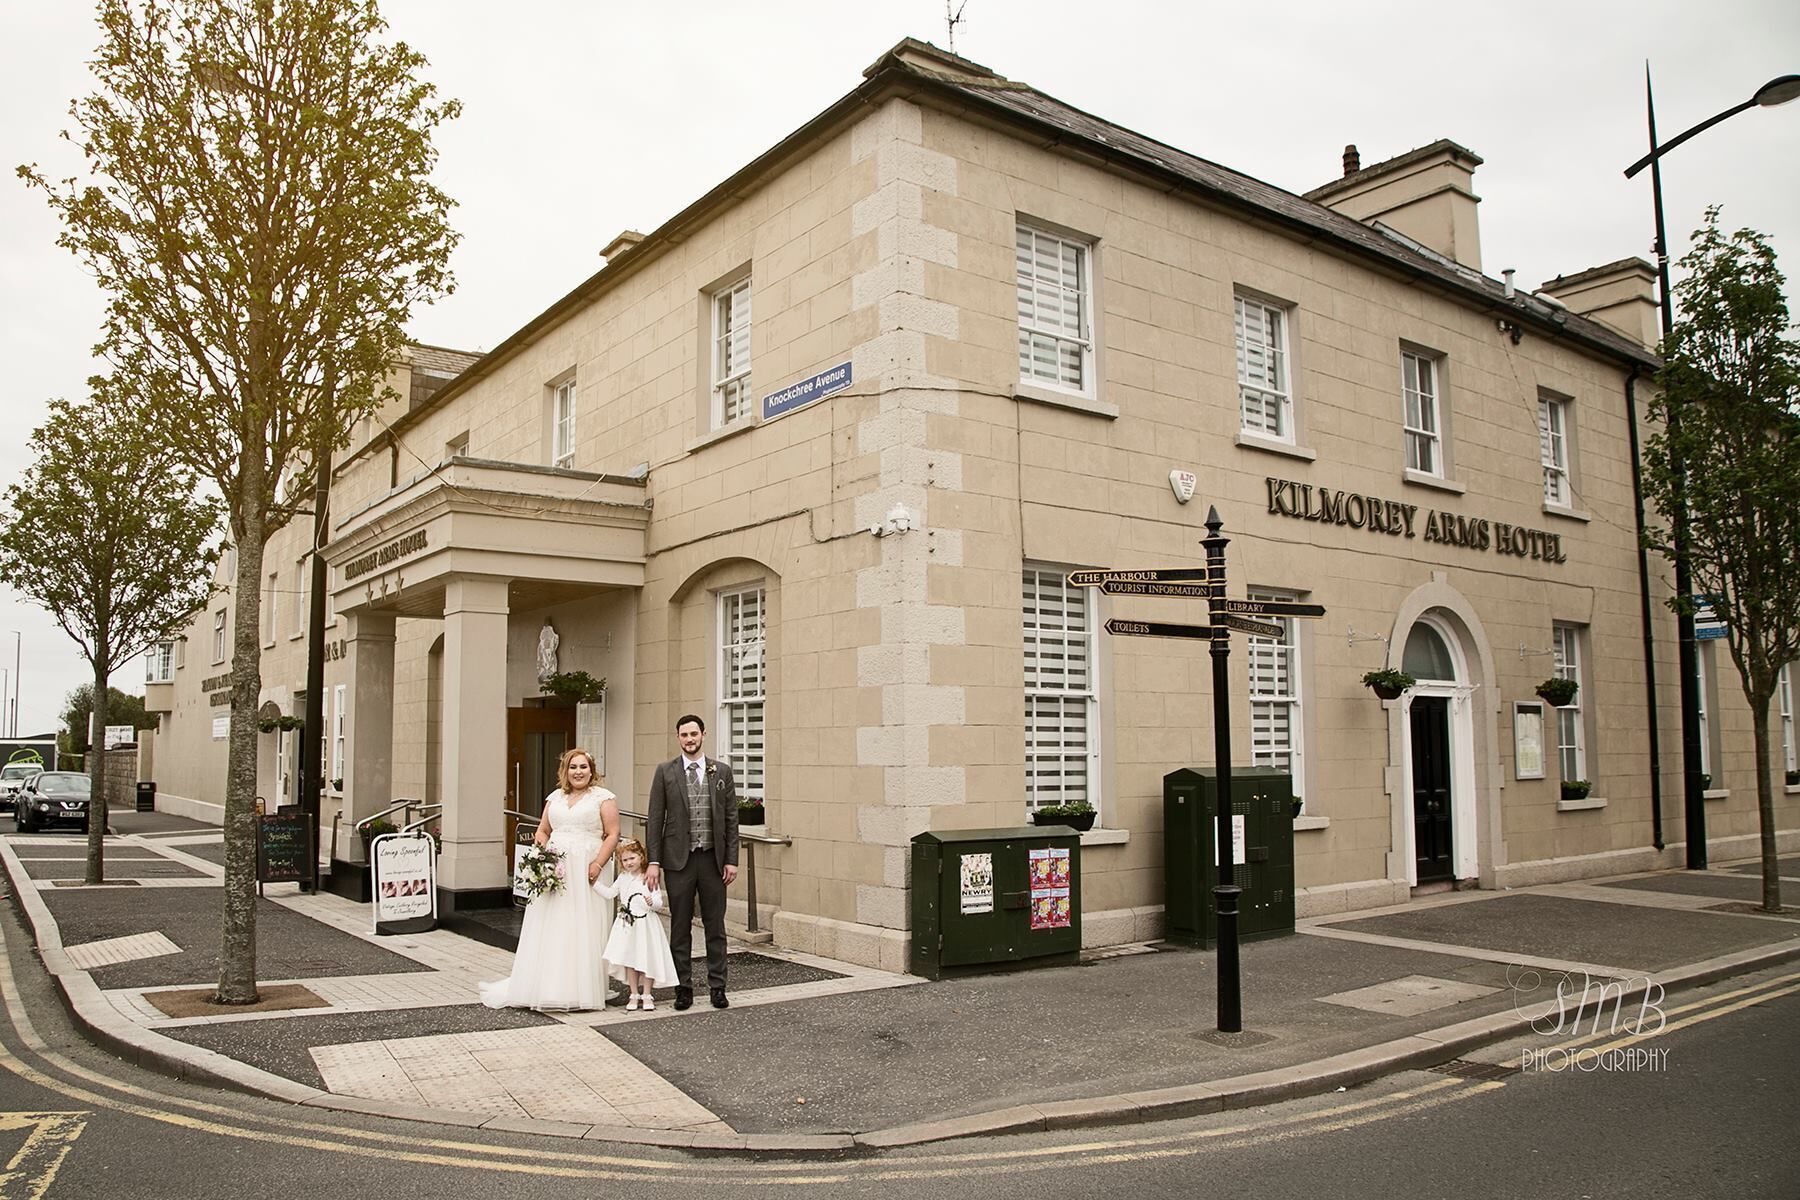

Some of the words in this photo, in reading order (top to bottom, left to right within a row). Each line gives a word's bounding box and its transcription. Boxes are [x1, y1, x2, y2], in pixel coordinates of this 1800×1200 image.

[768, 382, 813, 408] Knockchree
[815, 368, 845, 388] Avenue
[1266, 477, 1418, 538] KILMOREY
[1424, 510, 1490, 551] ARMS
[1494, 523, 1567, 563] HOTEL
[1077, 573, 1100, 582] THE
[1103, 572, 1158, 581] HARBOUR
[1108, 583, 1146, 592] TOURIST
[1149, 584, 1207, 595] INFORMATION
[1229, 603, 1264, 612] LIBRARY
[1113, 622, 1150, 633] TOILETS
[380, 848, 398, 858] Loving
[400, 845, 426, 858] Spoonful
[962, 888, 992, 896] NEWRY
